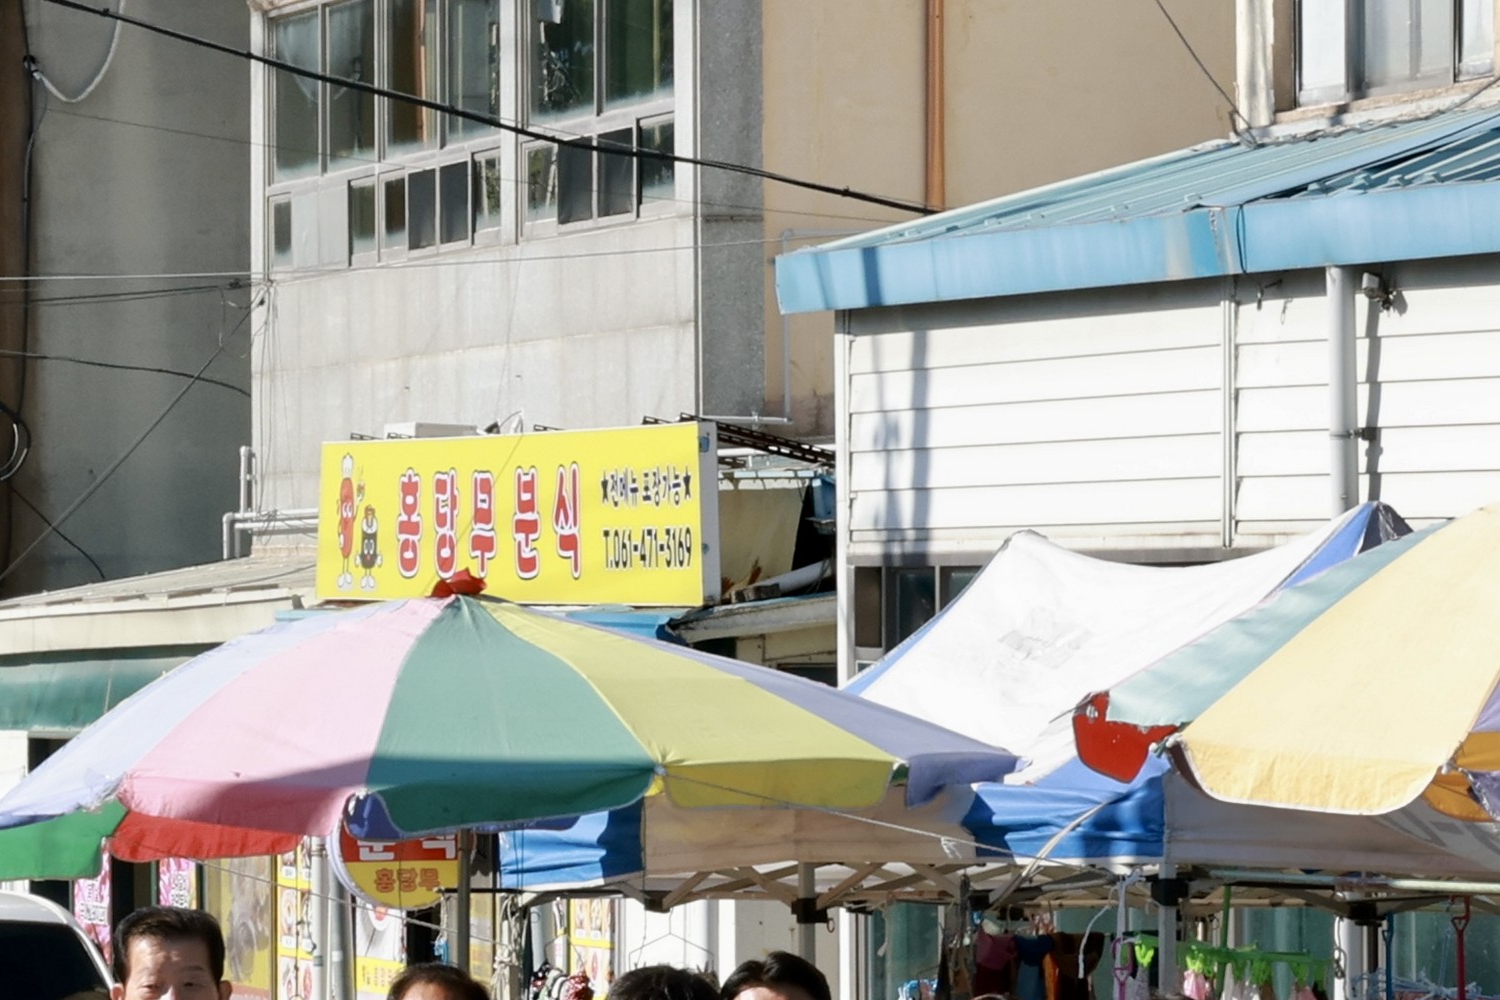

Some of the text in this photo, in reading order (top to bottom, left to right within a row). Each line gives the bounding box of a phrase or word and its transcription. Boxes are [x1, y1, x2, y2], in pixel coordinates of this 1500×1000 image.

[610, 466, 682, 507] 전메뉴 포장가능
[604, 528, 692, 568] T.061-471-3169
